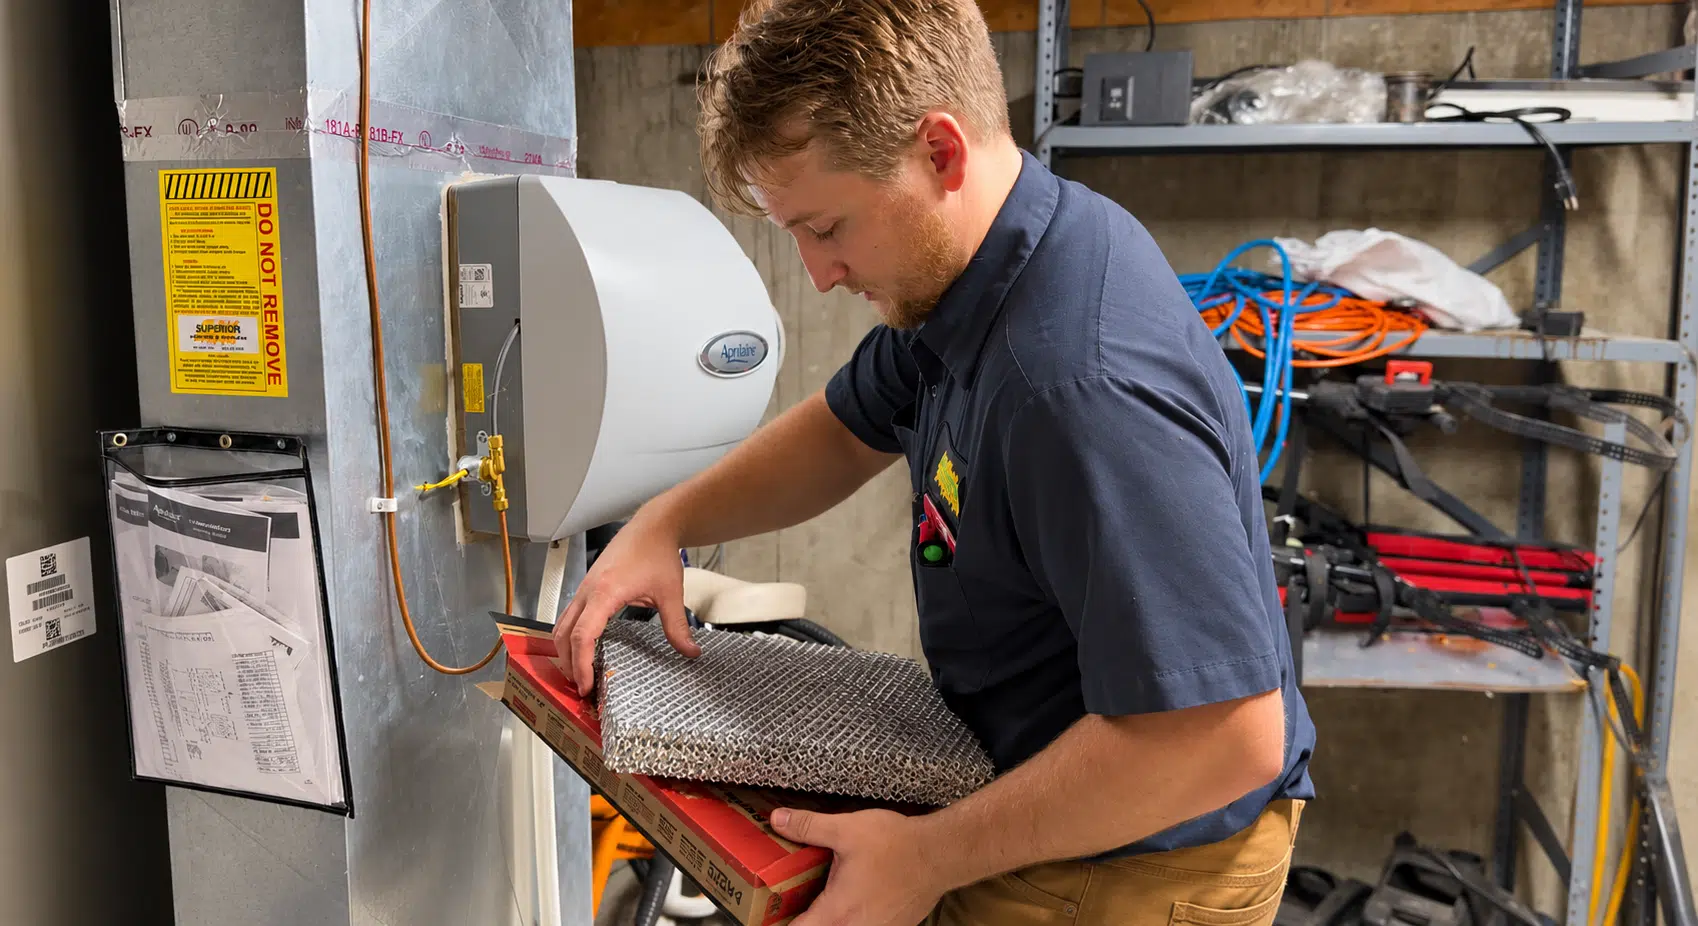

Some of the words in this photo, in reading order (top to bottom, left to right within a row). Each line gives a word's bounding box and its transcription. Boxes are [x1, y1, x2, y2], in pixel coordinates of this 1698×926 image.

[257, 203, 273, 236] DO
[260, 242, 277, 287] NOT
[263, 294, 282, 386] REMOVE
[720, 343, 757, 363] Aprilaire
